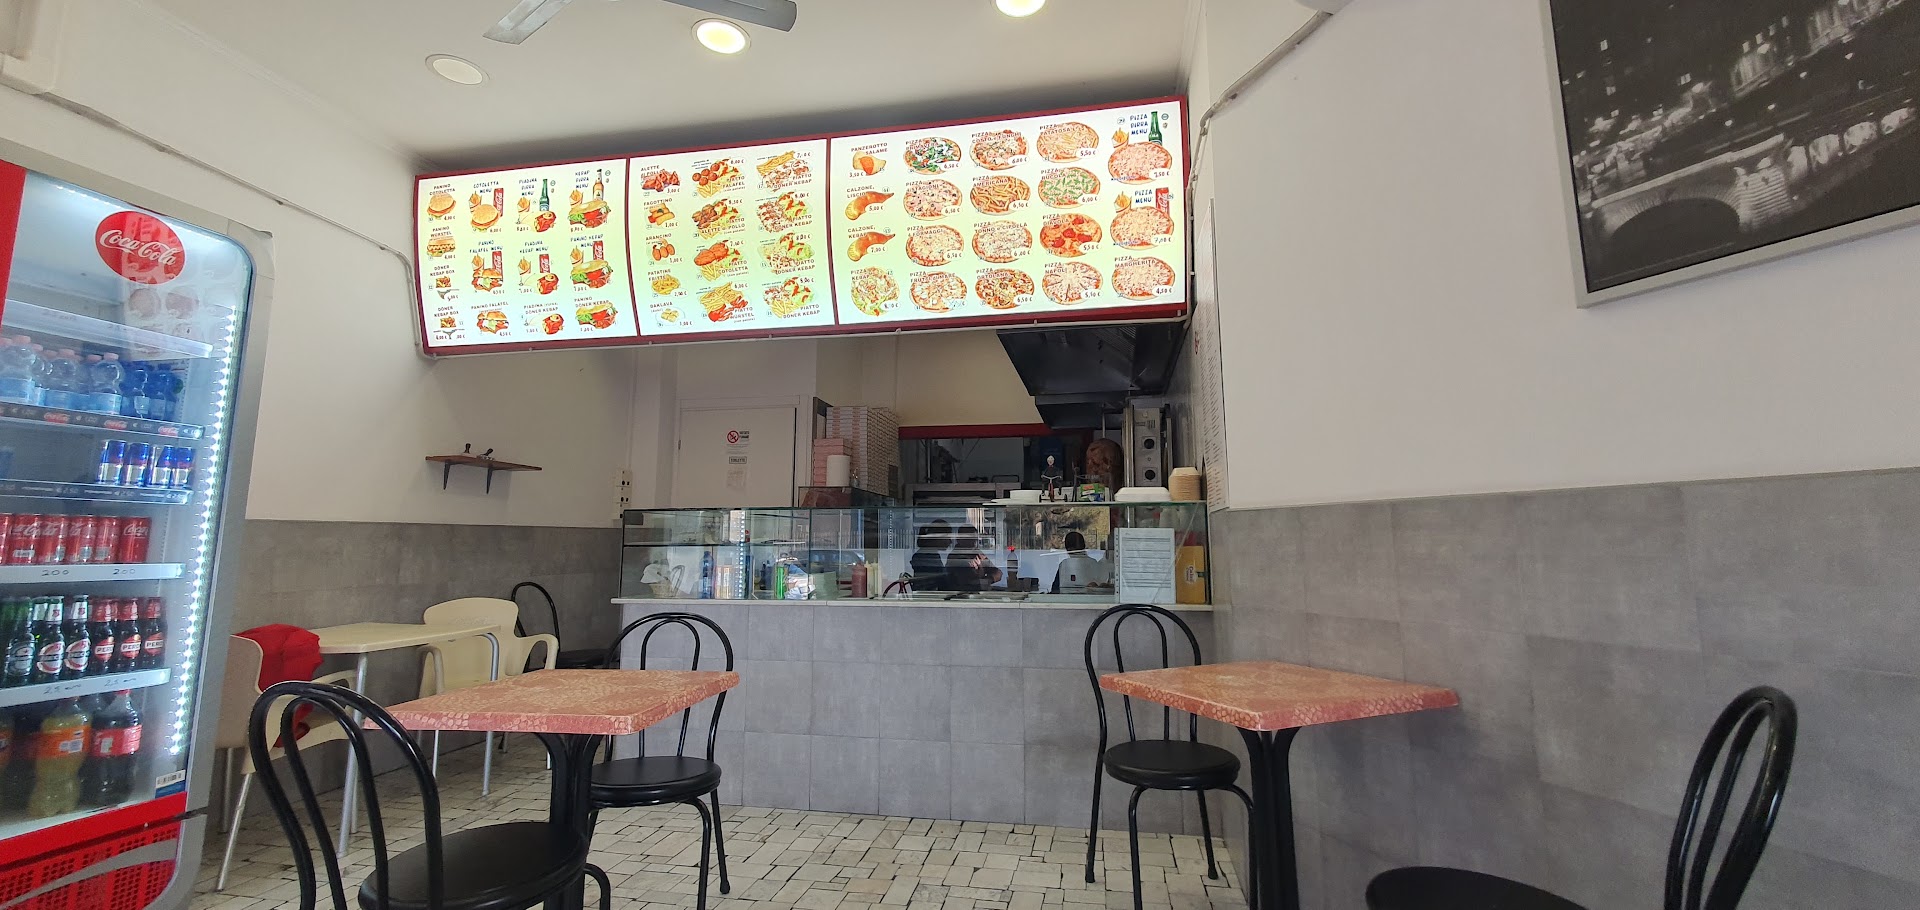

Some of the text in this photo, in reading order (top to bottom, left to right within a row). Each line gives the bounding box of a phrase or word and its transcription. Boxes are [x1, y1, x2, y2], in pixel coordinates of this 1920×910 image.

[1130, 113, 1148, 121] PIZZA
[1130, 121, 1149, 129] BIRRA
[1040, 127, 1071, 136] PATATOSA
[851, 142, 888, 152] PANZEROTTO
[865, 148, 888, 156] SALAME
[973, 179, 1008, 187] AMERICANA
[643, 198, 673, 206] FAGOTTINO
[645, 233, 672, 241] ARANCINO
[100, 229, 181, 266] Coca-Cola
[1114, 259, 1156, 268] MARGHERITA
[717, 266, 749, 274] COTOLETTA
